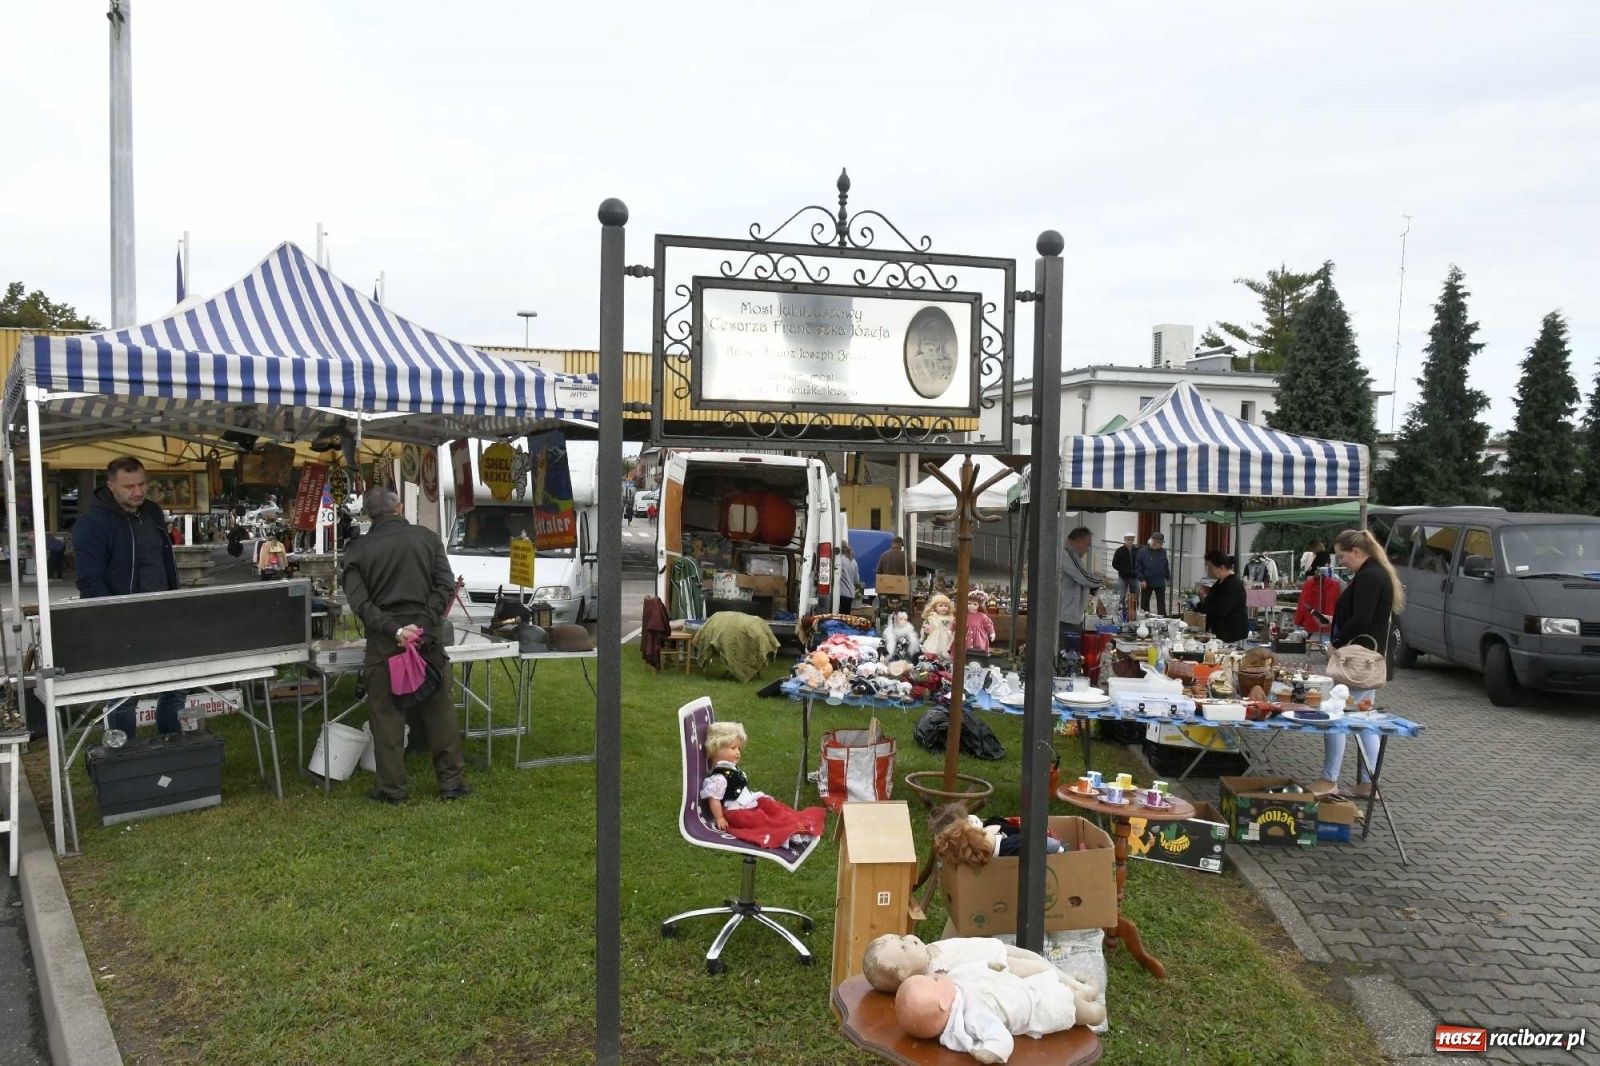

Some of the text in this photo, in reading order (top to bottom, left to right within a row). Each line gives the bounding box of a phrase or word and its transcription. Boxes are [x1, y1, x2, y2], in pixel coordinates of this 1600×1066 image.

[740, 301, 773, 315] Most
[709, 316, 890, 341] Cesarza Franciszka Józefa
